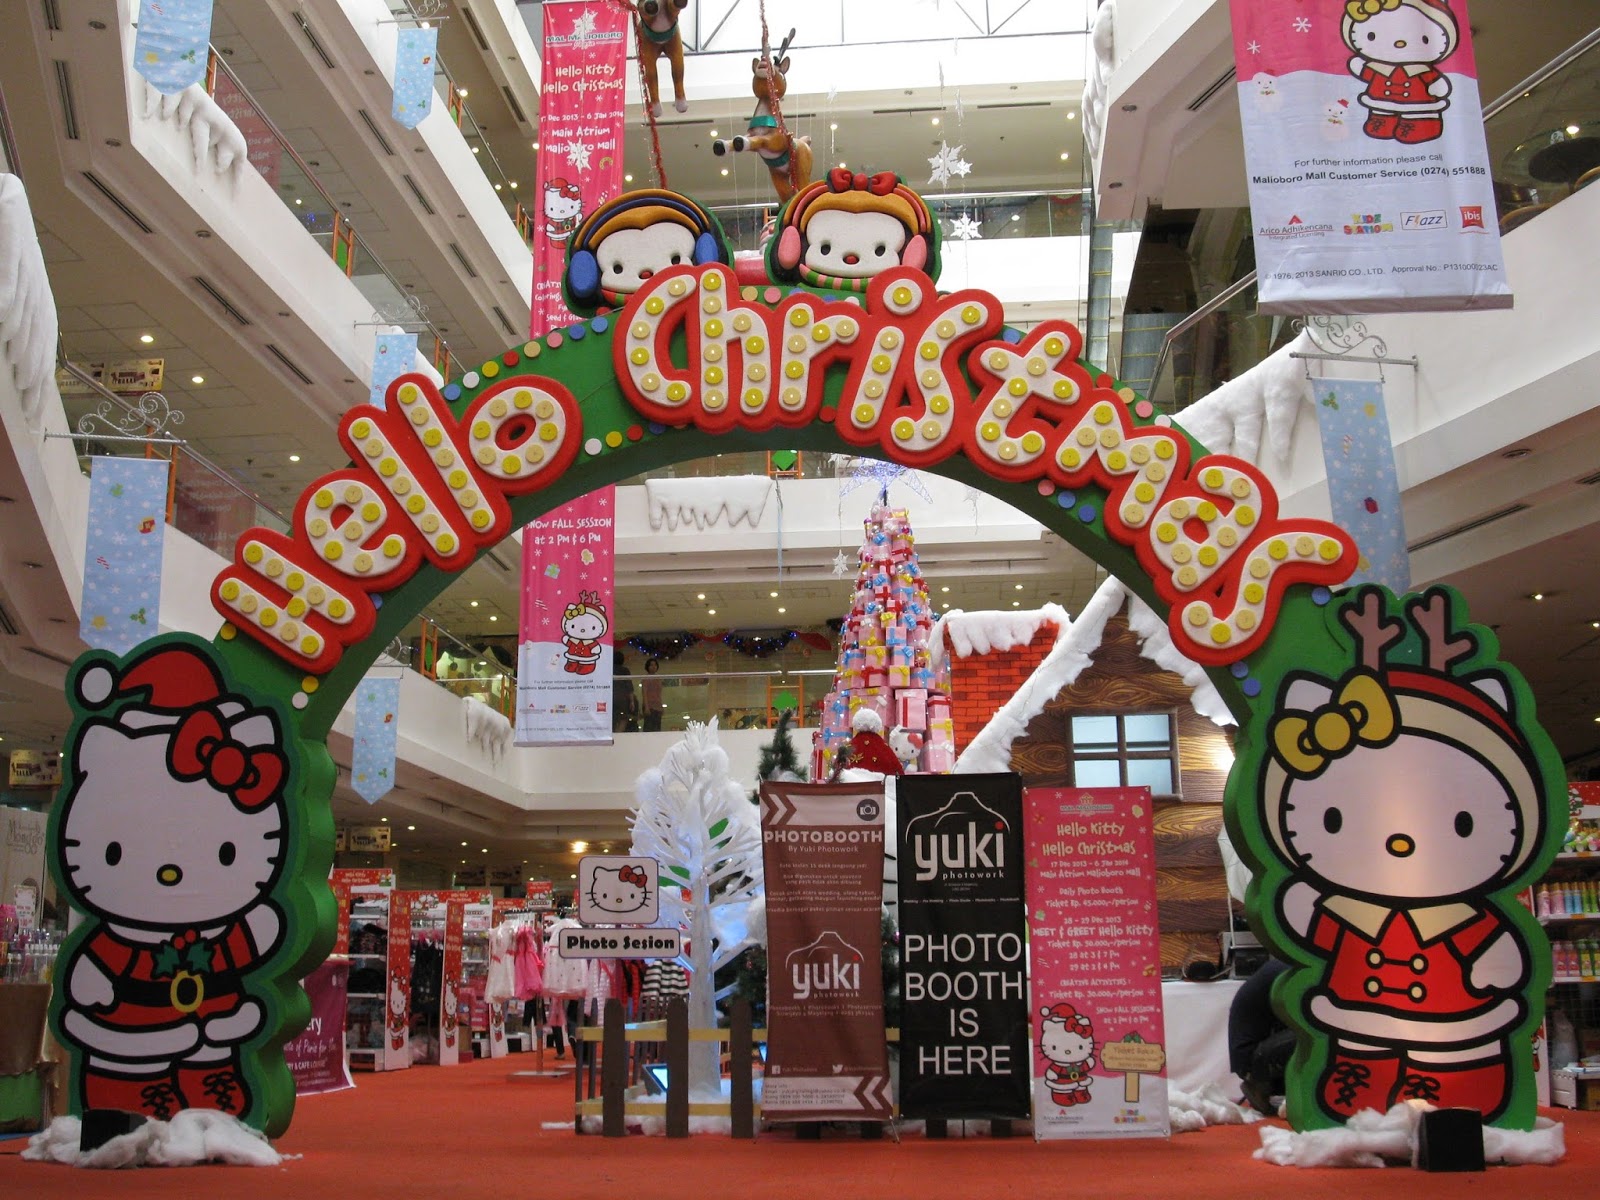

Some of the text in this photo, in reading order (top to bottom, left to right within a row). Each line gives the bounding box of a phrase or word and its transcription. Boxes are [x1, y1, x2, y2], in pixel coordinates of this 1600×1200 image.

[568, 32, 624, 41] MAIOBORO
[556, 64, 616, 78] Hello Kitty
[548, 114, 560, 122] Dec
[563, 113, 579, 121] 2013
[586, 112, 591, 120] 6
[552, 125, 610, 137] Main Atrium
[546, 138, 616, 154] Malioro Mall
[1294, 153, 1443, 168] For further information please call
[1253, 166, 1486, 184] Malioboro Mall Customer Service (0274) 551888
[1464, 211, 1480, 221] ibis
[1260, 222, 1333, 235] Arico Adhikencana
[1273, 272, 1292, 280] 1976,
[1315, 269, 1347, 278] SANRIO
[1392, 264, 1424, 274] Approval
[220, 269, 1343, 659] Hello Christmas
[552, 518, 574, 529] FALL
[576, 517, 612, 528] SESSION
[534, 536, 546, 544] at
[548, 535, 554, 544] 2
[557, 534, 570, 546] PM
[580, 534, 586, 543] 6
[588, 532, 600, 544] PM
[1056, 822, 1124, 837] Hello Kitty
[764, 830, 882, 844] PHOTOBOOTH
[914, 821, 1004, 880] yuki
[1042, 840, 1136, 857] Hello Christmas
[943, 870, 1004, 880] photowork
[1040, 867, 1140, 878] Main Atrium Malioboro Mall
[1078, 886, 1100, 896] Photo
[1101, 886, 1124, 895] Booth
[1045, 899, 1068, 908] Ticket
[1032, 927, 1056, 936] MEET
[1067, 926, 1096, 936] GREET
[1098, 924, 1123, 937] Hello
[1125, 924, 1154, 936] Kitty
[567, 936, 674, 950] Photo Sesion
[905, 932, 1022, 962] PHOTO
[1047, 939, 1070, 948] Ticket
[792, 954, 860, 1000] yuki
[906, 971, 1024, 1002] BOOTH
[814, 990, 860, 999] photowork
[1048, 990, 1072, 1000] Ticket
[950, 1008, 980, 1038] IS
[920, 1045, 1012, 1076] HERE
